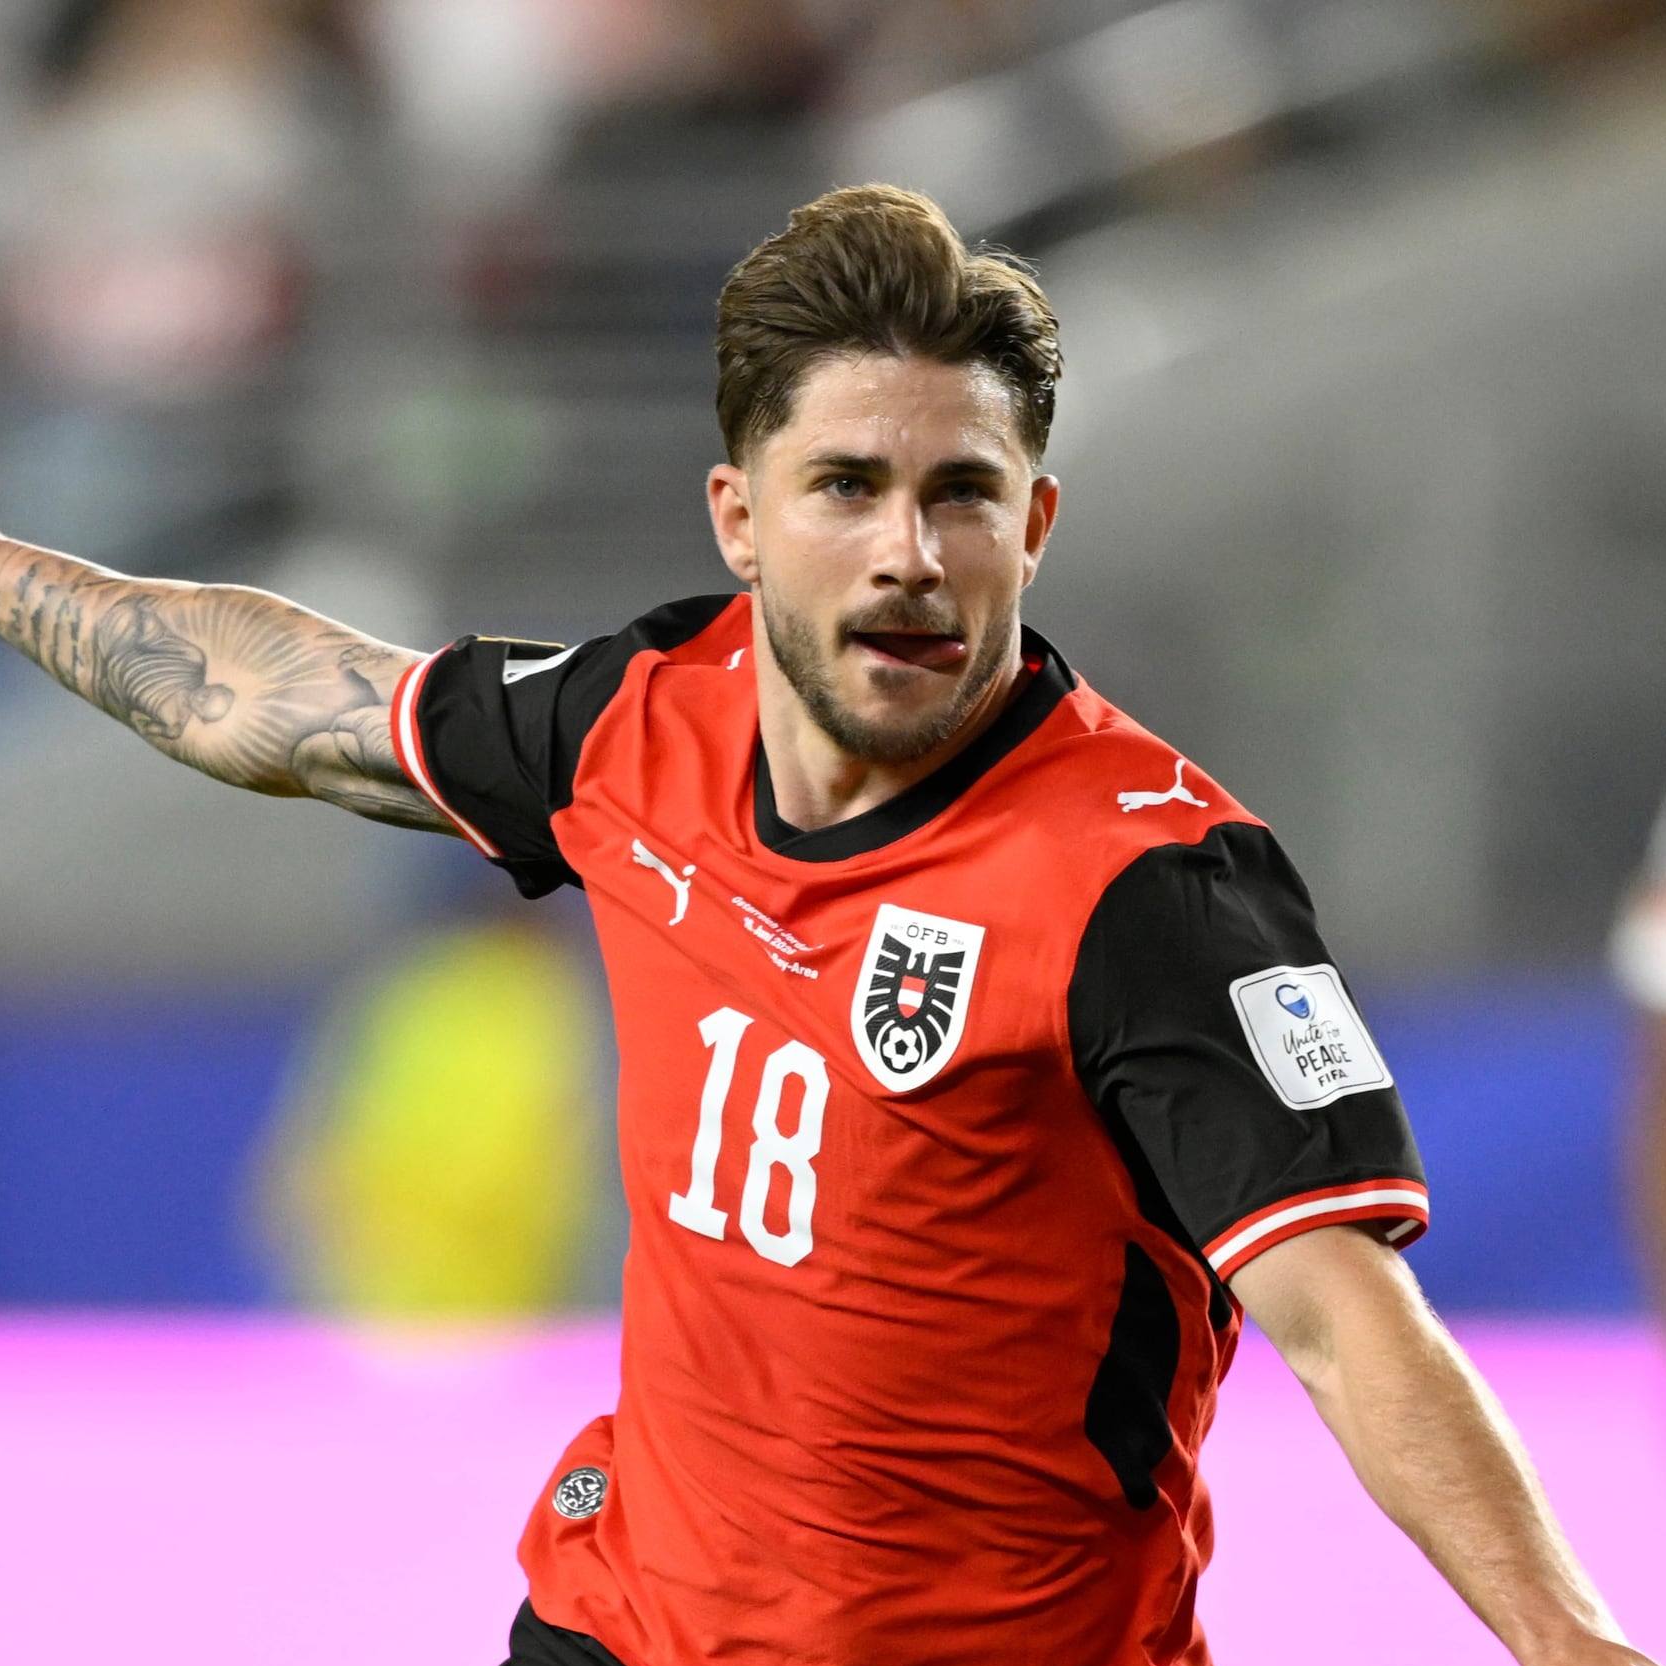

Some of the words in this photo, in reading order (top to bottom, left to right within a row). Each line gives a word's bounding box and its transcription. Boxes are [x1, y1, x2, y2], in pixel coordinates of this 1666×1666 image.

[906, 921, 949, 945] ÖFB
[1283, 1023, 1322, 1055] Unite
[1321, 1020, 1340, 1038] For
[1296, 1043, 1352, 1077] PEACE
[1318, 1069, 1348, 1087] FIFA
[669, 1006, 830, 1268] 18
